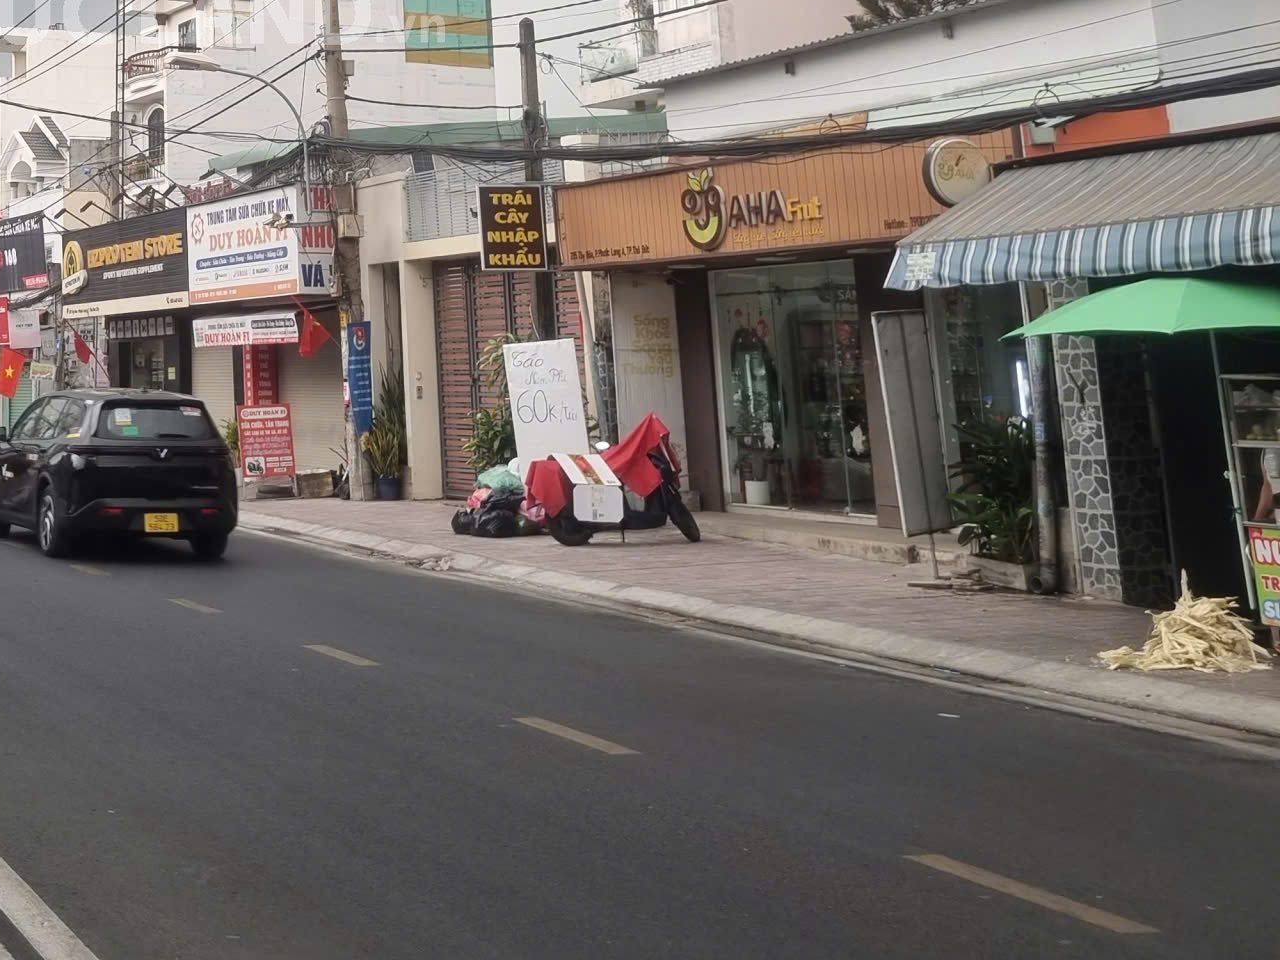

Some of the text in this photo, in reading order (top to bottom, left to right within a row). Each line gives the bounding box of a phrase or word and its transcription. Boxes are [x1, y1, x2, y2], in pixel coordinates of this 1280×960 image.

[489, 189, 532, 205] TRÁI
[206, 210, 225, 226] TRUNG
[267, 200, 275, 214] XE
[494, 208, 529, 224] CÂY
[728, 189, 789, 228] AHA
[144, 233, 183, 259] STORE
[209, 230, 234, 252] DUY
[237, 222, 272, 247] HOÀN
[487, 227, 539, 246] NHẬP
[488, 246, 541, 265] KHẨU
[301, 260, 325, 287] VÁ
[204, 333, 221, 344] DUY
[221, 329, 241, 343] HOÀN
